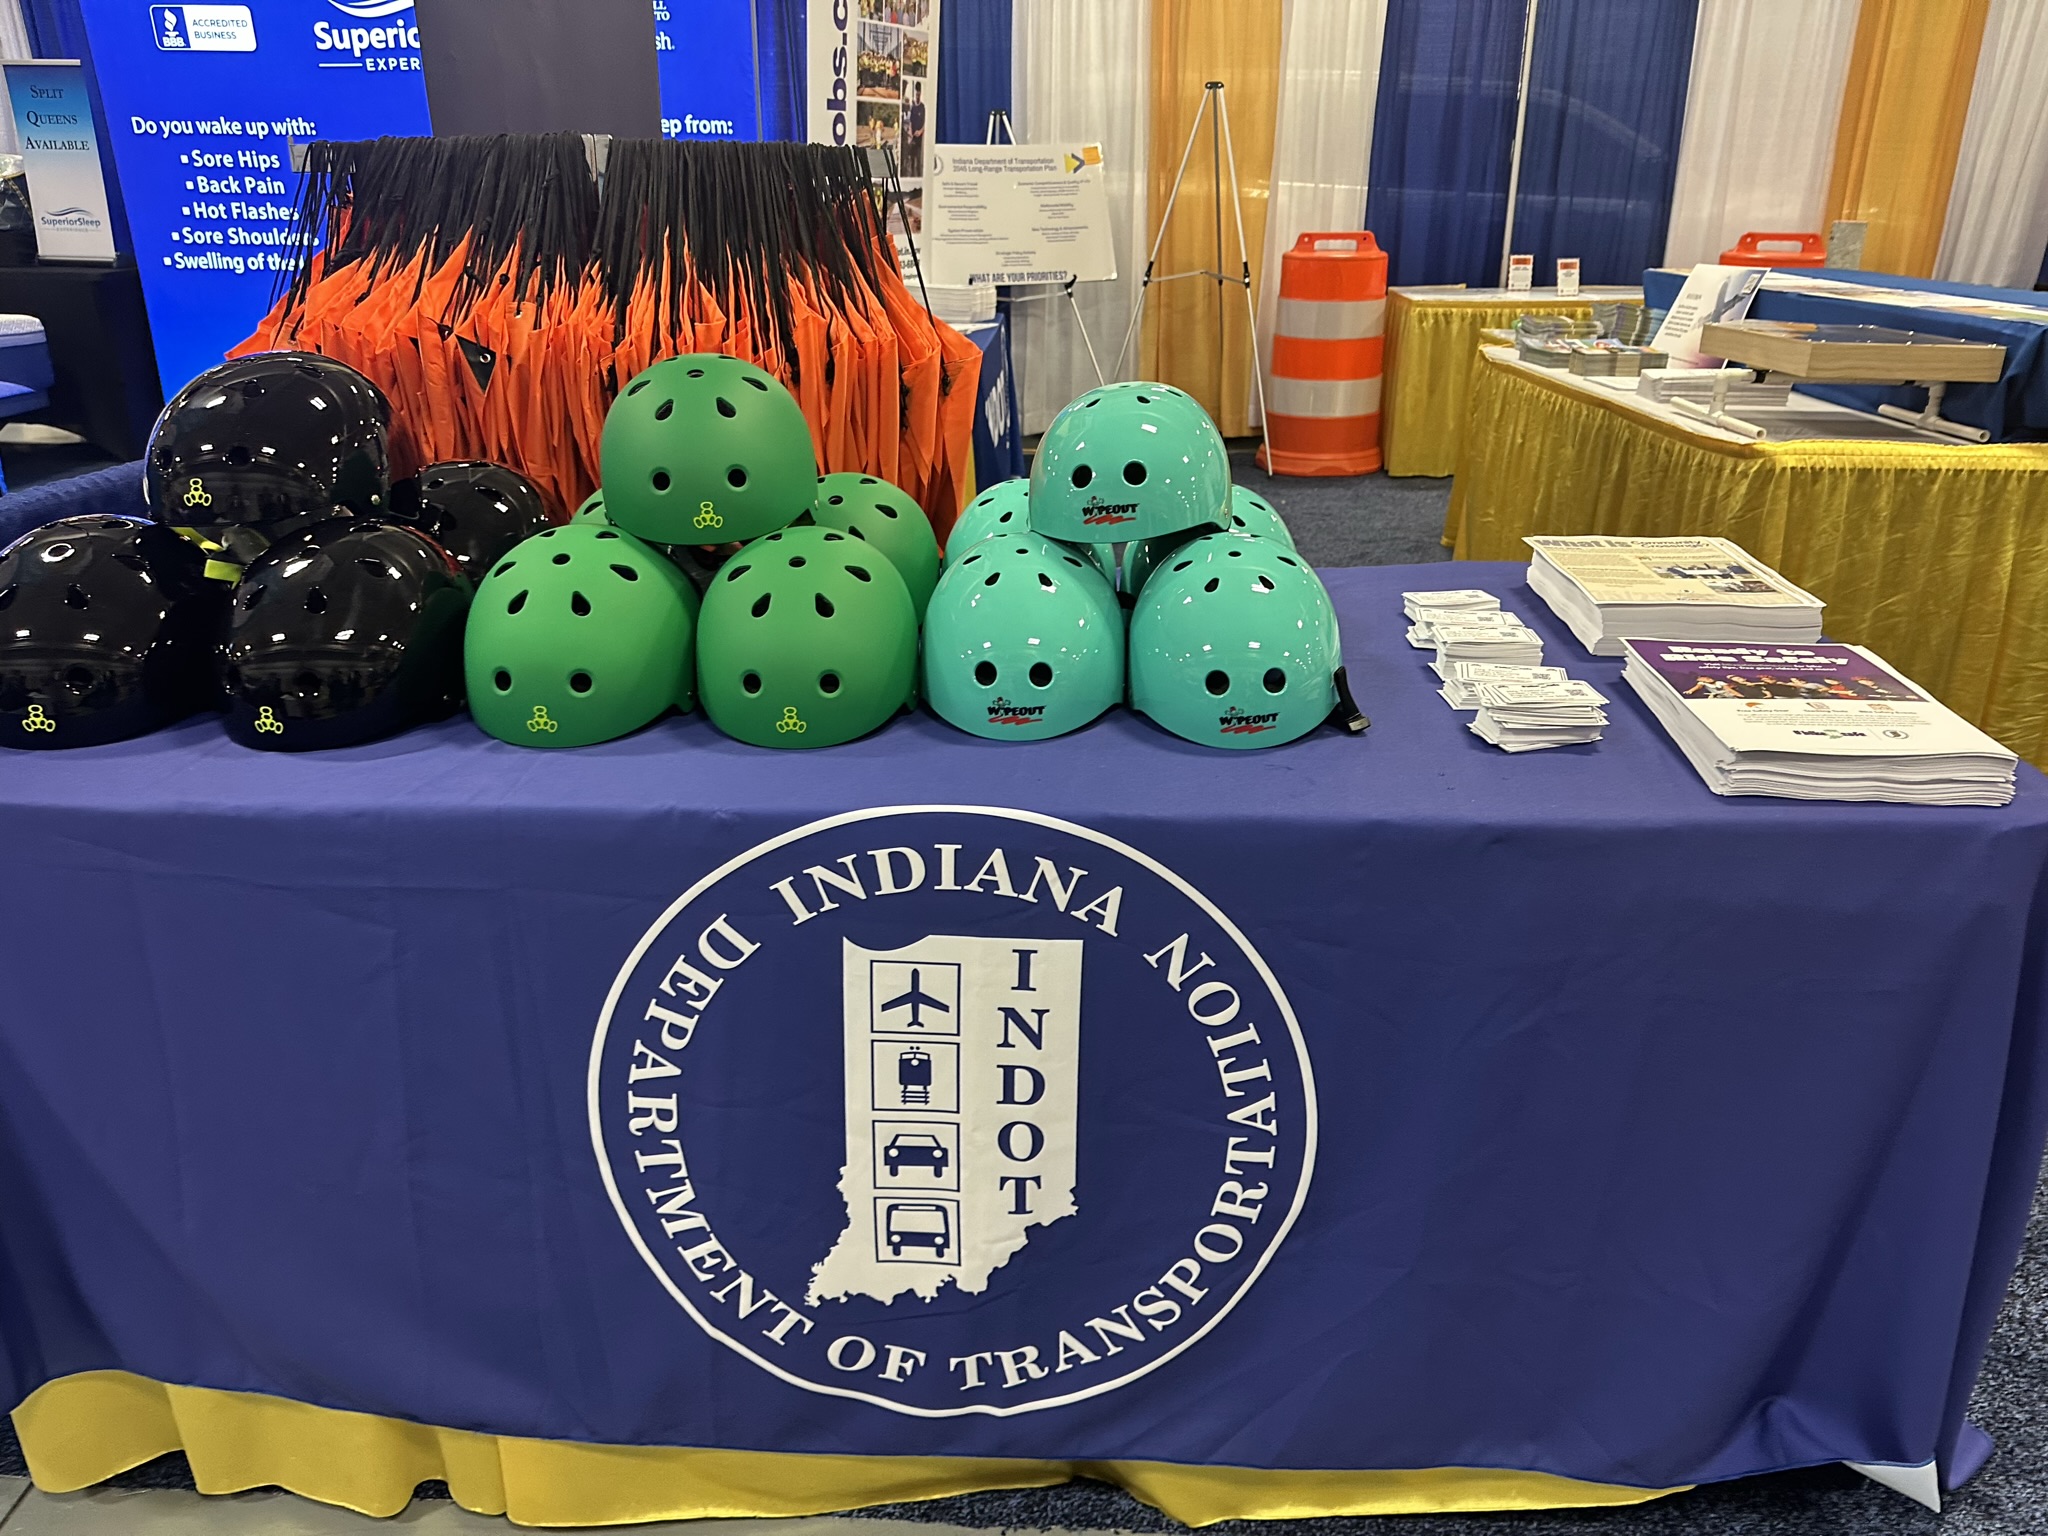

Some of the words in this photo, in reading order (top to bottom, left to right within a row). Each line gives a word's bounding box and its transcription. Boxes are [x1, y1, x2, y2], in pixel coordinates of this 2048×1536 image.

[192, 19, 248, 27] ACCREDITED
[194, 31, 236, 39] BUSINESS
[366, 58, 420, 71] EXPER
[30, 84, 64, 99] SPLIT
[26, 110, 78, 128] QUEENS
[131, 116, 157, 134] Do
[160, 120, 193, 138] you
[196, 116, 242, 135] wake
[245, 122, 268, 139] up
[271, 117, 316, 136] with:
[684, 114, 734, 135] from:
[26, 136, 90, 150] AVAILABLE
[191, 150, 234, 168] Sore
[238, 150, 280, 172] Hips
[196, 176, 242, 194] Back
[244, 176, 286, 194] Pain
[192, 202, 228, 219] Hot
[230, 202, 300, 220] Flashes
[41, 216, 100, 228] SuperiorSleep
[182, 227, 224, 244] Sore
[174, 252, 244, 274] Swelling
[247, 252, 265, 270] of
[970, 273, 990, 283] WHAT
[992, 273, 1006, 282] ARE
[1006, 272, 1025, 282] YOUR
[769, 842, 1124, 937] INDIANA
[996, 948, 1050, 1215] INDOT
[627, 912, 815, 1347] DEPARTMENT
[826, 1334, 927, 1382] OF
[950, 933, 1278, 1391] TRANSPORTATION
